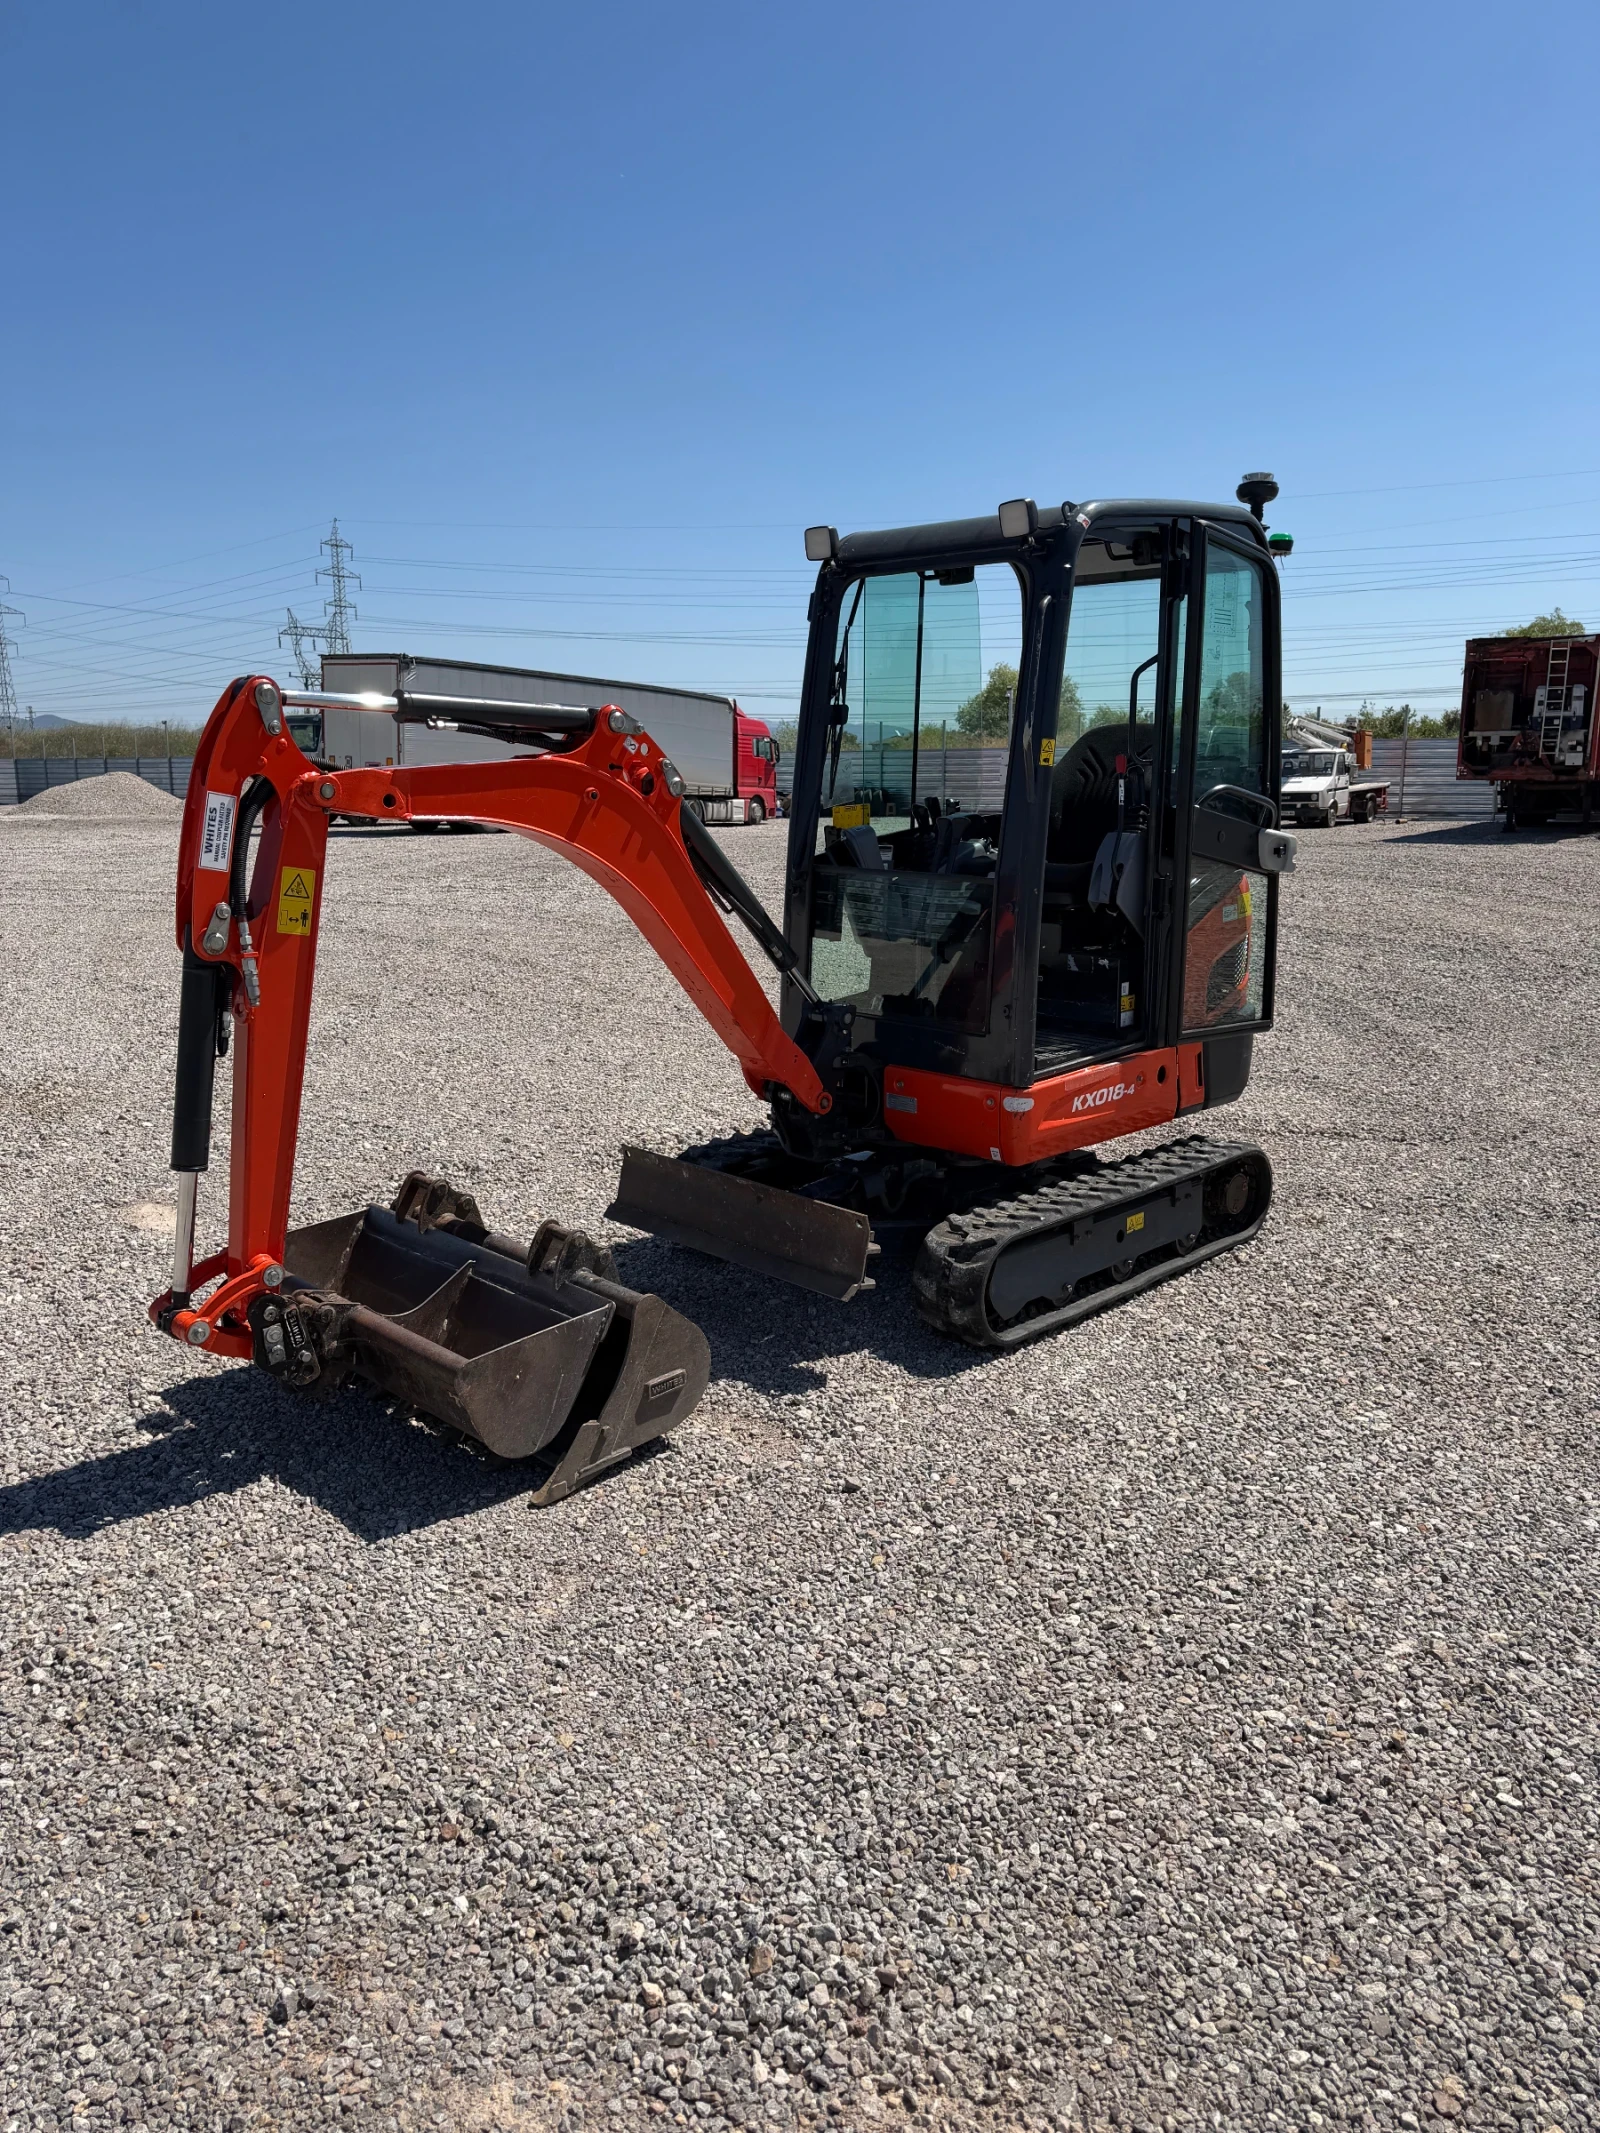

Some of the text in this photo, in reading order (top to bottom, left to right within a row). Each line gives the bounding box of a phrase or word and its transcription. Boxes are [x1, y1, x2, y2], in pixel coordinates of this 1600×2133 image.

[204, 807, 218, 854] WHITES
[216, 818, 224, 842] COUPLER
[220, 842, 228, 860] SAFETY
[224, 807, 232, 832] REQUIRED
[288, 1308, 303, 1345] WHITES
[651, 1375, 684, 1395] WHITES
